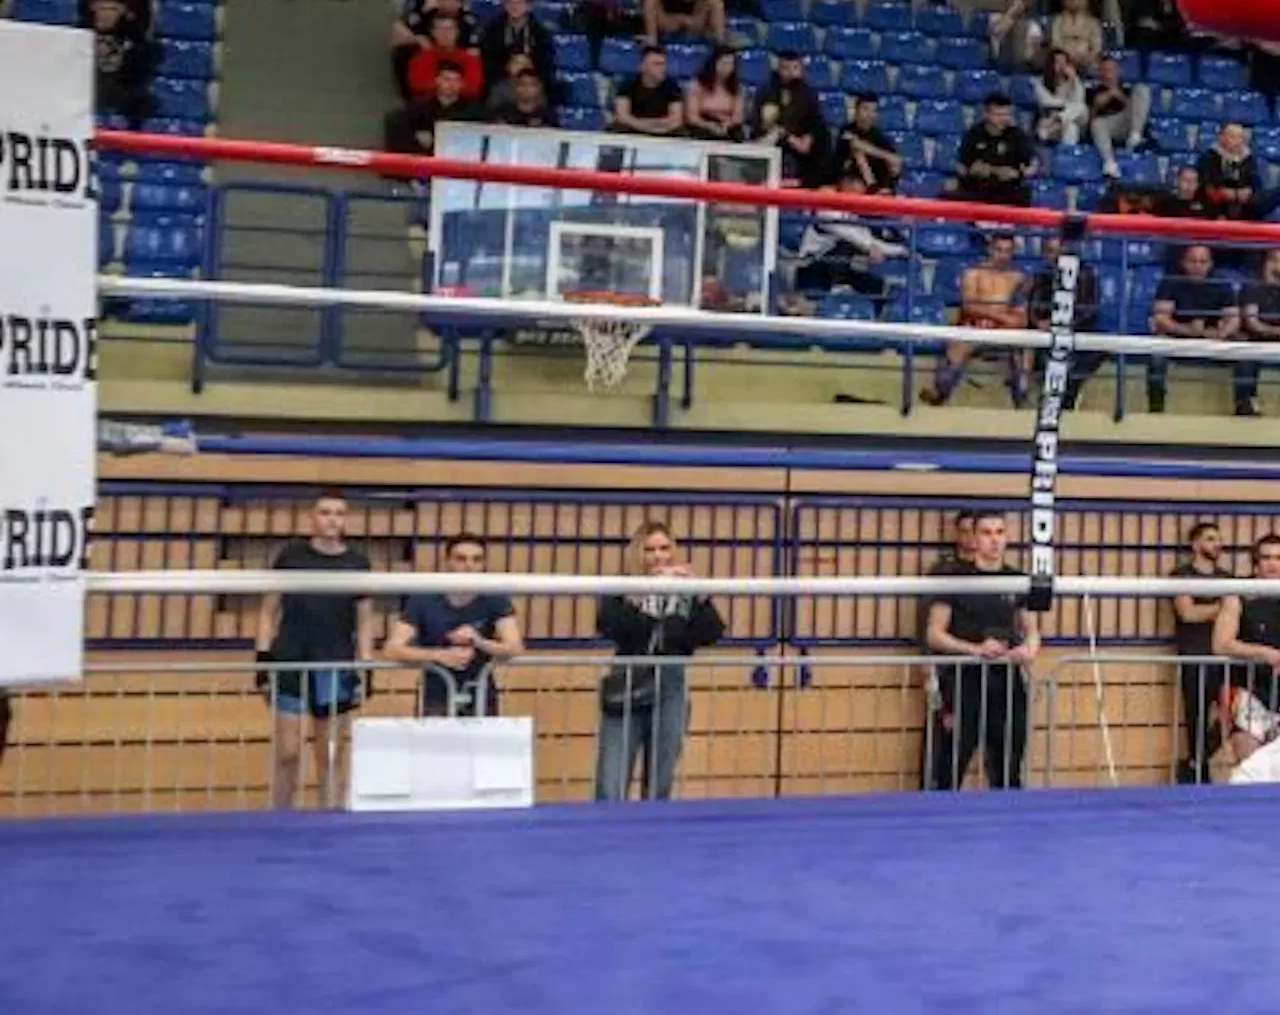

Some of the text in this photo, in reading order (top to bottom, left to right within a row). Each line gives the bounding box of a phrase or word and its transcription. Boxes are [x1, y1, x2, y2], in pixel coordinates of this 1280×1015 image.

[0, 132, 92, 198] RID
[0, 316, 97, 380] RIDE
[0, 508, 89, 570] RID
